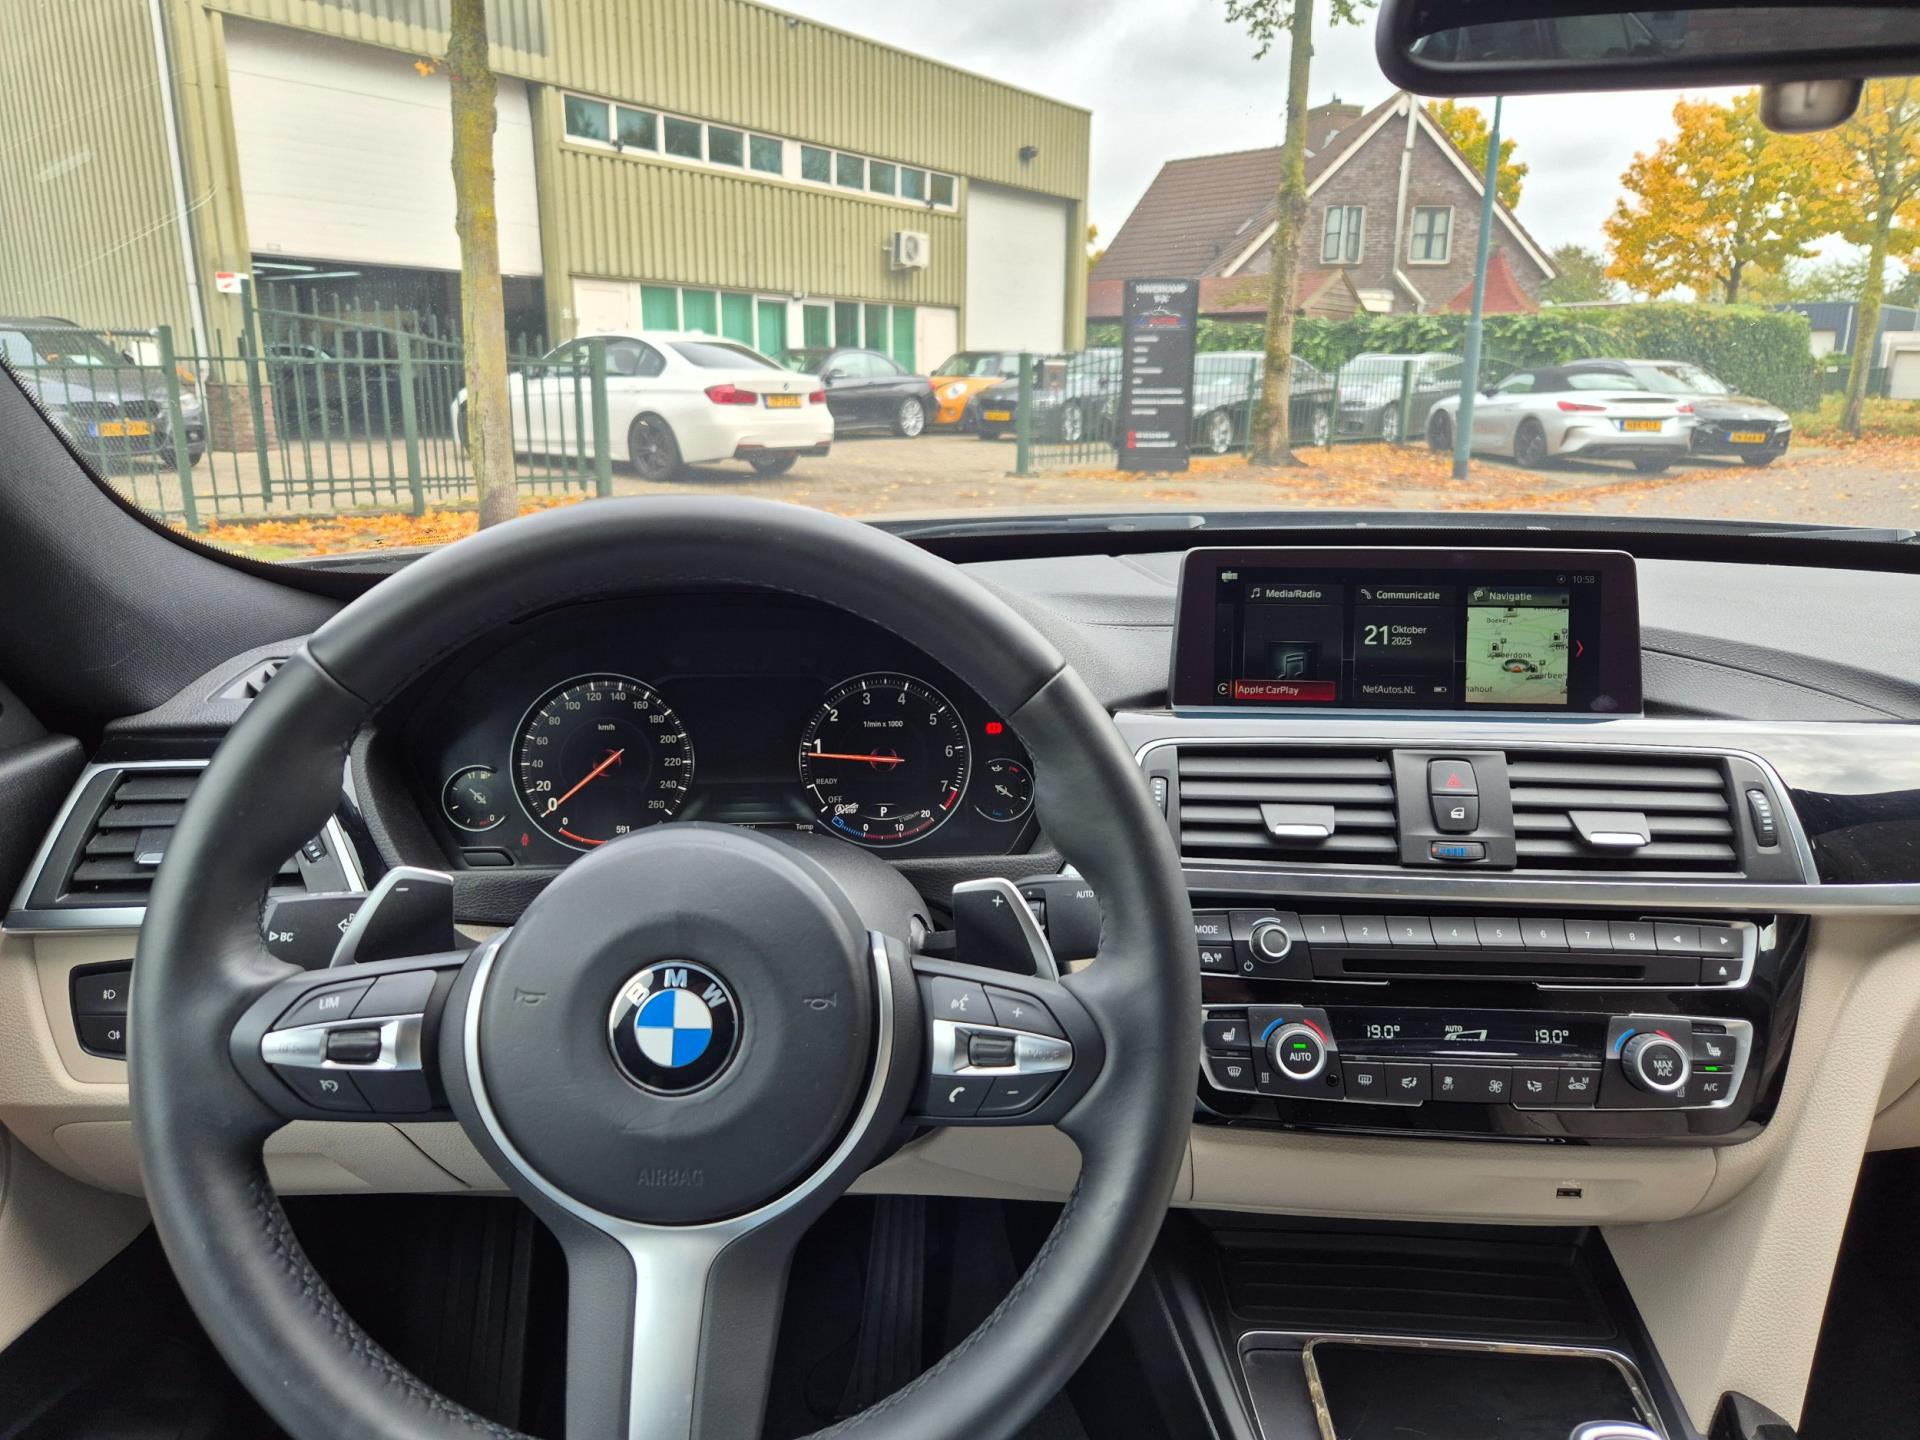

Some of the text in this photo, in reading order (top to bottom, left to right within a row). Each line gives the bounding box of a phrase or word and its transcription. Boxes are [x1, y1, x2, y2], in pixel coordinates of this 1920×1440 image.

[1573, 575, 1595, 584] 10:58
[1265, 589, 1322, 599] Media/Radio
[1376, 590, 1440, 600] Communicatie
[1489, 591, 1532, 602] Navigatie
[1391, 625, 1427, 634] Oktober
[1364, 624, 1389, 645] 21
[1391, 636, 1412, 645] 2025
[1237, 685, 1300, 696] Apple CarPlay
[1362, 685, 1416, 694] NetAutos.NL
[586, 692, 602, 701] 120
[611, 692, 626, 701] 140
[862, 693, 871, 705] 3
[897, 693, 906, 705] 4
[565, 702, 581, 711] 100
[633, 701, 649, 710] 160
[649, 715, 665, 724] 180
[830, 709, 839, 722] 2
[929, 713, 938, 726] 5
[549, 716, 560, 726] 80
[863, 720, 881, 728] 1/min
[888, 720, 903, 728] 1000
[598, 723, 615, 732] km/h
[536, 736, 548, 746] 60
[660, 735, 677, 744] 200
[813, 738, 822, 754] 1
[945, 745, 954, 758] 6
[532, 759, 543, 769] 40
[664, 757, 681, 767] 220
[660, 780, 677, 789] 240
[816, 777, 838, 785] READY
[536, 780, 551, 792] 20
[940, 780, 949, 792] 7
[828, 795, 842, 804] OFF
[547, 797, 558, 812] 0
[648, 800, 665, 809] 260
[880, 806, 888, 817] P
[920, 809, 931, 818] 20
[489, 814, 495, 822] 0
[562, 817, 568, 825] 0
[616, 825, 630, 834] 591
[796, 823, 814, 831] Temp
[863, 823, 869, 831] 0
[894, 823, 904, 831] 10
[1076, 889, 1094, 898] AUTO
[1194, 924, 1219, 934] MODE
[1320, 926, 1326, 934] 1
[1361, 927, 1369, 936] 2
[1406, 927, 1413, 937] 3
[1451, 928, 1458, 937] 4
[1496, 929, 1503, 938] 5
[279, 931, 294, 942] BC
[1540, 930, 1547, 939] 6
[1584, 931, 1591, 940] 7
[1628, 932, 1636, 941] 8
[625, 968, 727, 1009] BMW
[318, 996, 340, 1010] LIM
[1444, 1025, 1463, 1033] AUTO
[1289, 1052, 1312, 1062] AUTO
[1653, 1060, 1673, 1068] MAX
[1657, 1068, 1673, 1077] A/C
[1569, 1077, 1589, 1085] A M
[1703, 1082, 1718, 1092] A/C
[637, 1167, 704, 1188] AIRBAG
